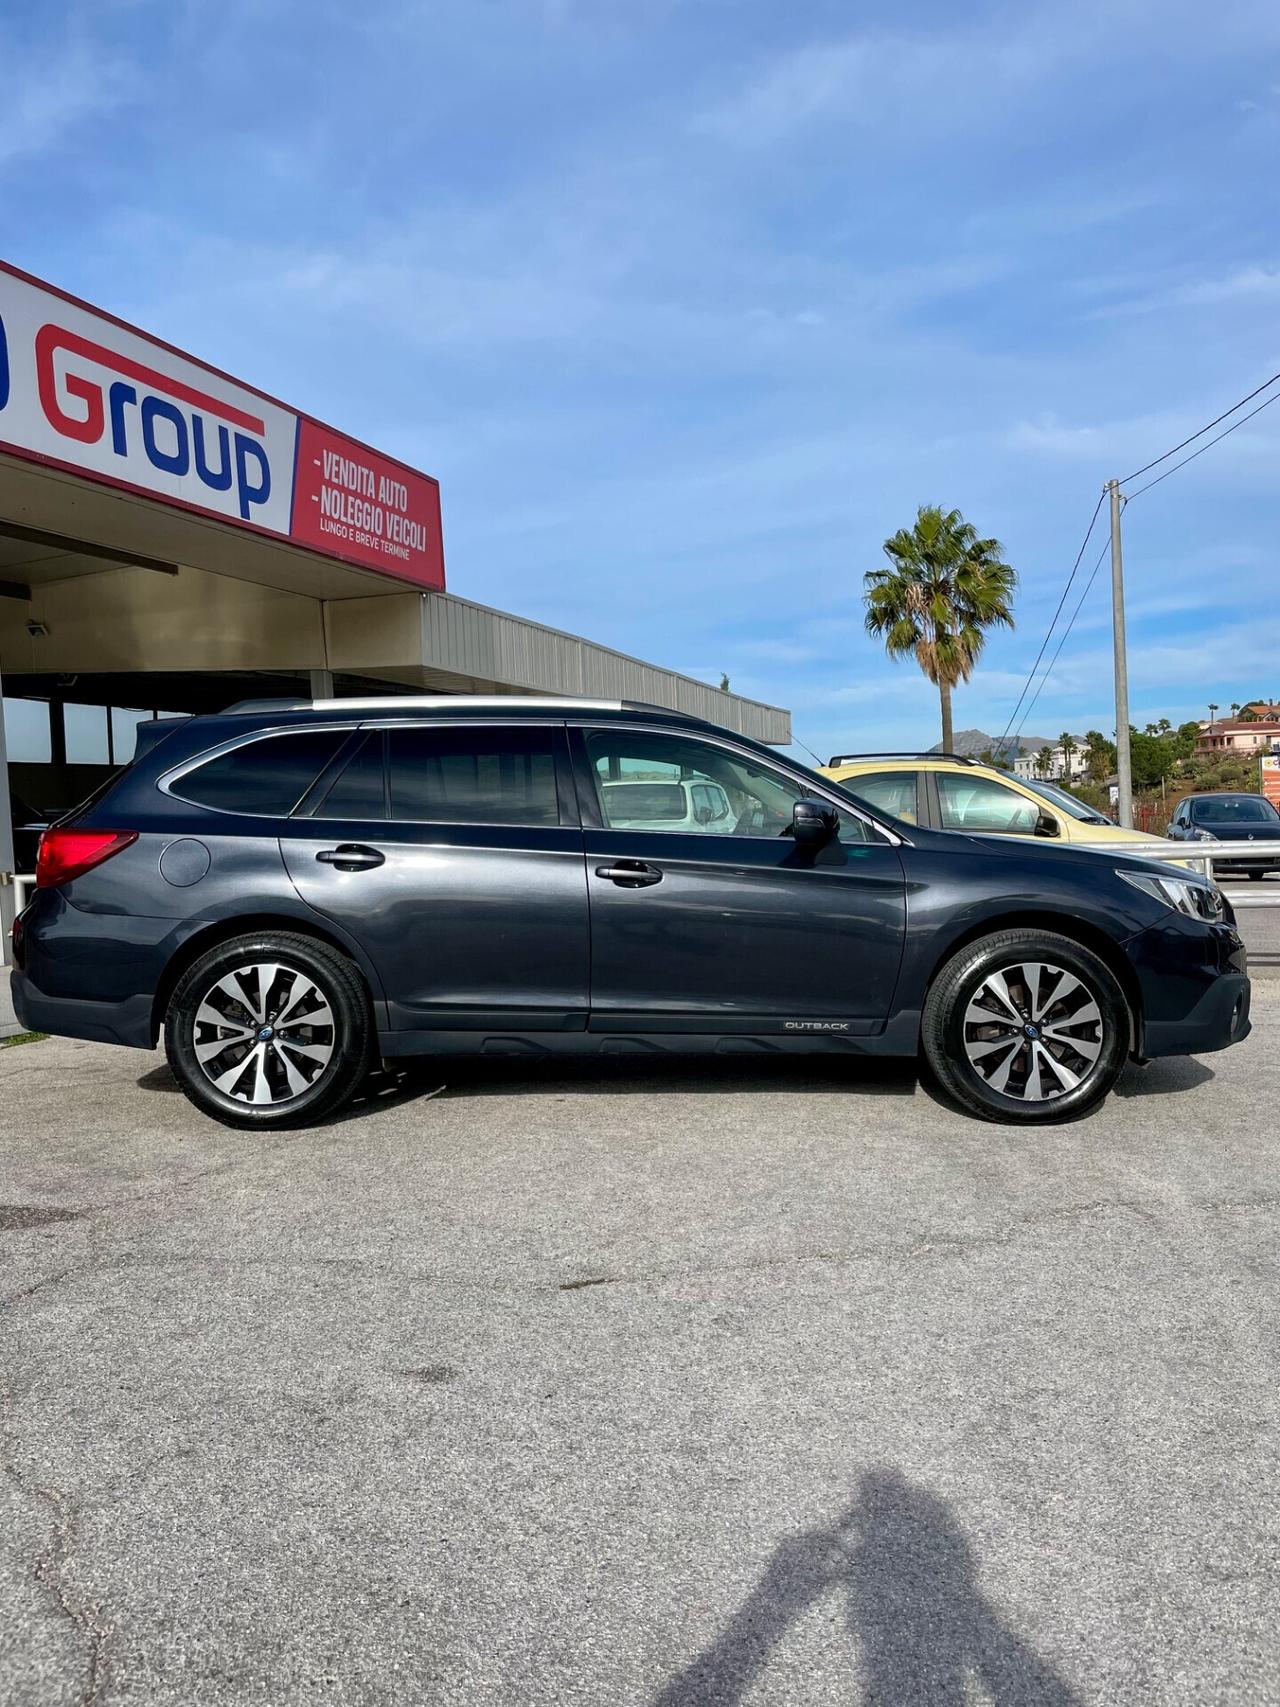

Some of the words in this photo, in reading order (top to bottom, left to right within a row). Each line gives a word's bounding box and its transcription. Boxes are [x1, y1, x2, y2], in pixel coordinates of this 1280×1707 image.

[35, 323, 271, 520] Group
[378, 476, 408, 513] AUTO
[320, 517, 347, 538] LUNGO
[348, 528, 354, 541] E
[355, 531, 379, 550] BREVE
[380, 540, 410, 561] TERMINE
[386, 511, 426, 552] VEICOLI
[785, 1022, 848, 1030] OUTBACK
